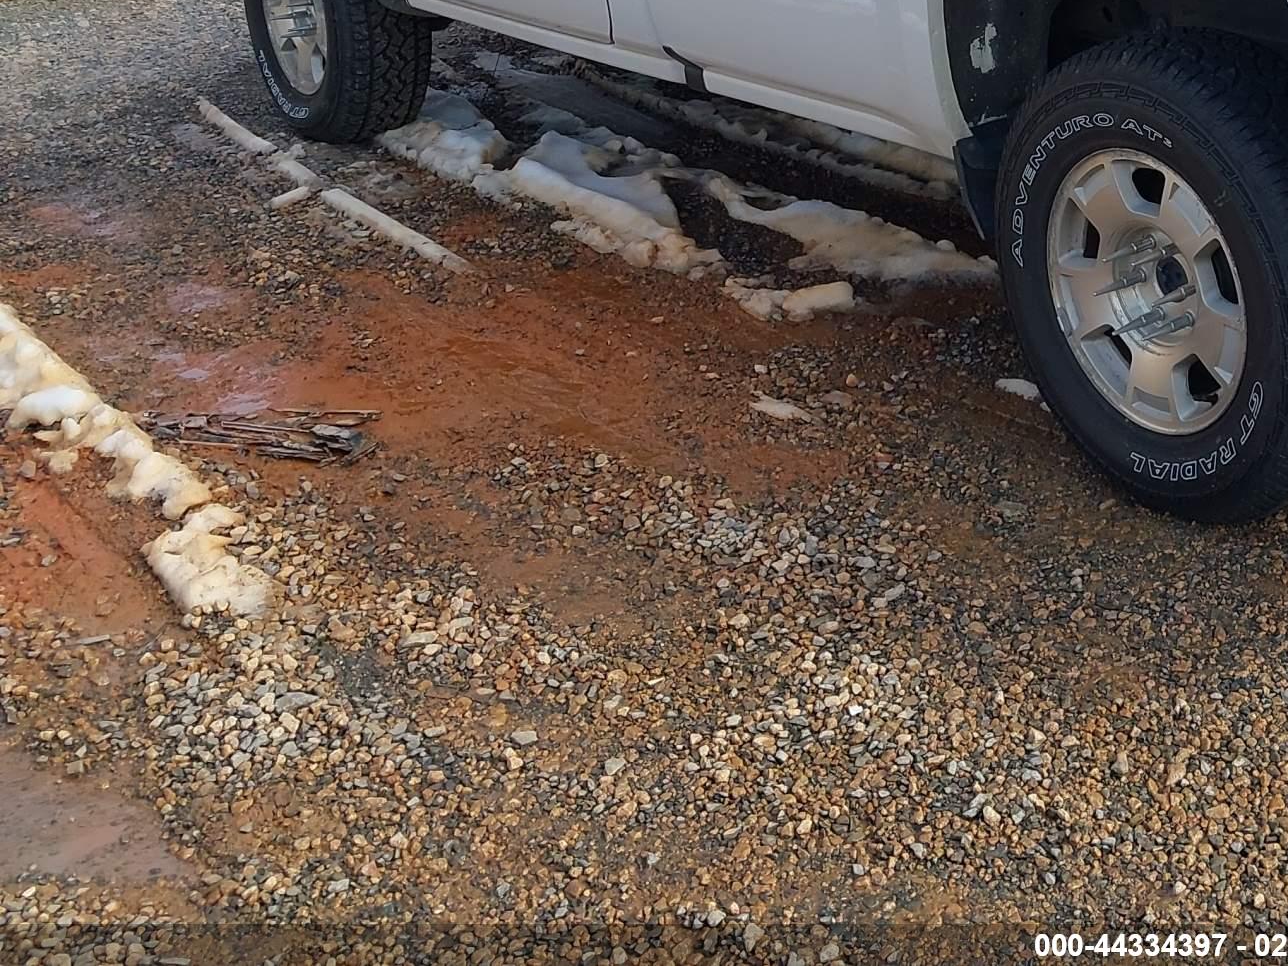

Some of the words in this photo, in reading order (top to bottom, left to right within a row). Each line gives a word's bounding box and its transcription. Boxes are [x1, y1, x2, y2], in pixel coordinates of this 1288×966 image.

[1011, 113, 1115, 268] ADVENTURO
[1240, 381, 1263, 446] GT
[1130, 437, 1237, 481] RADIAL
